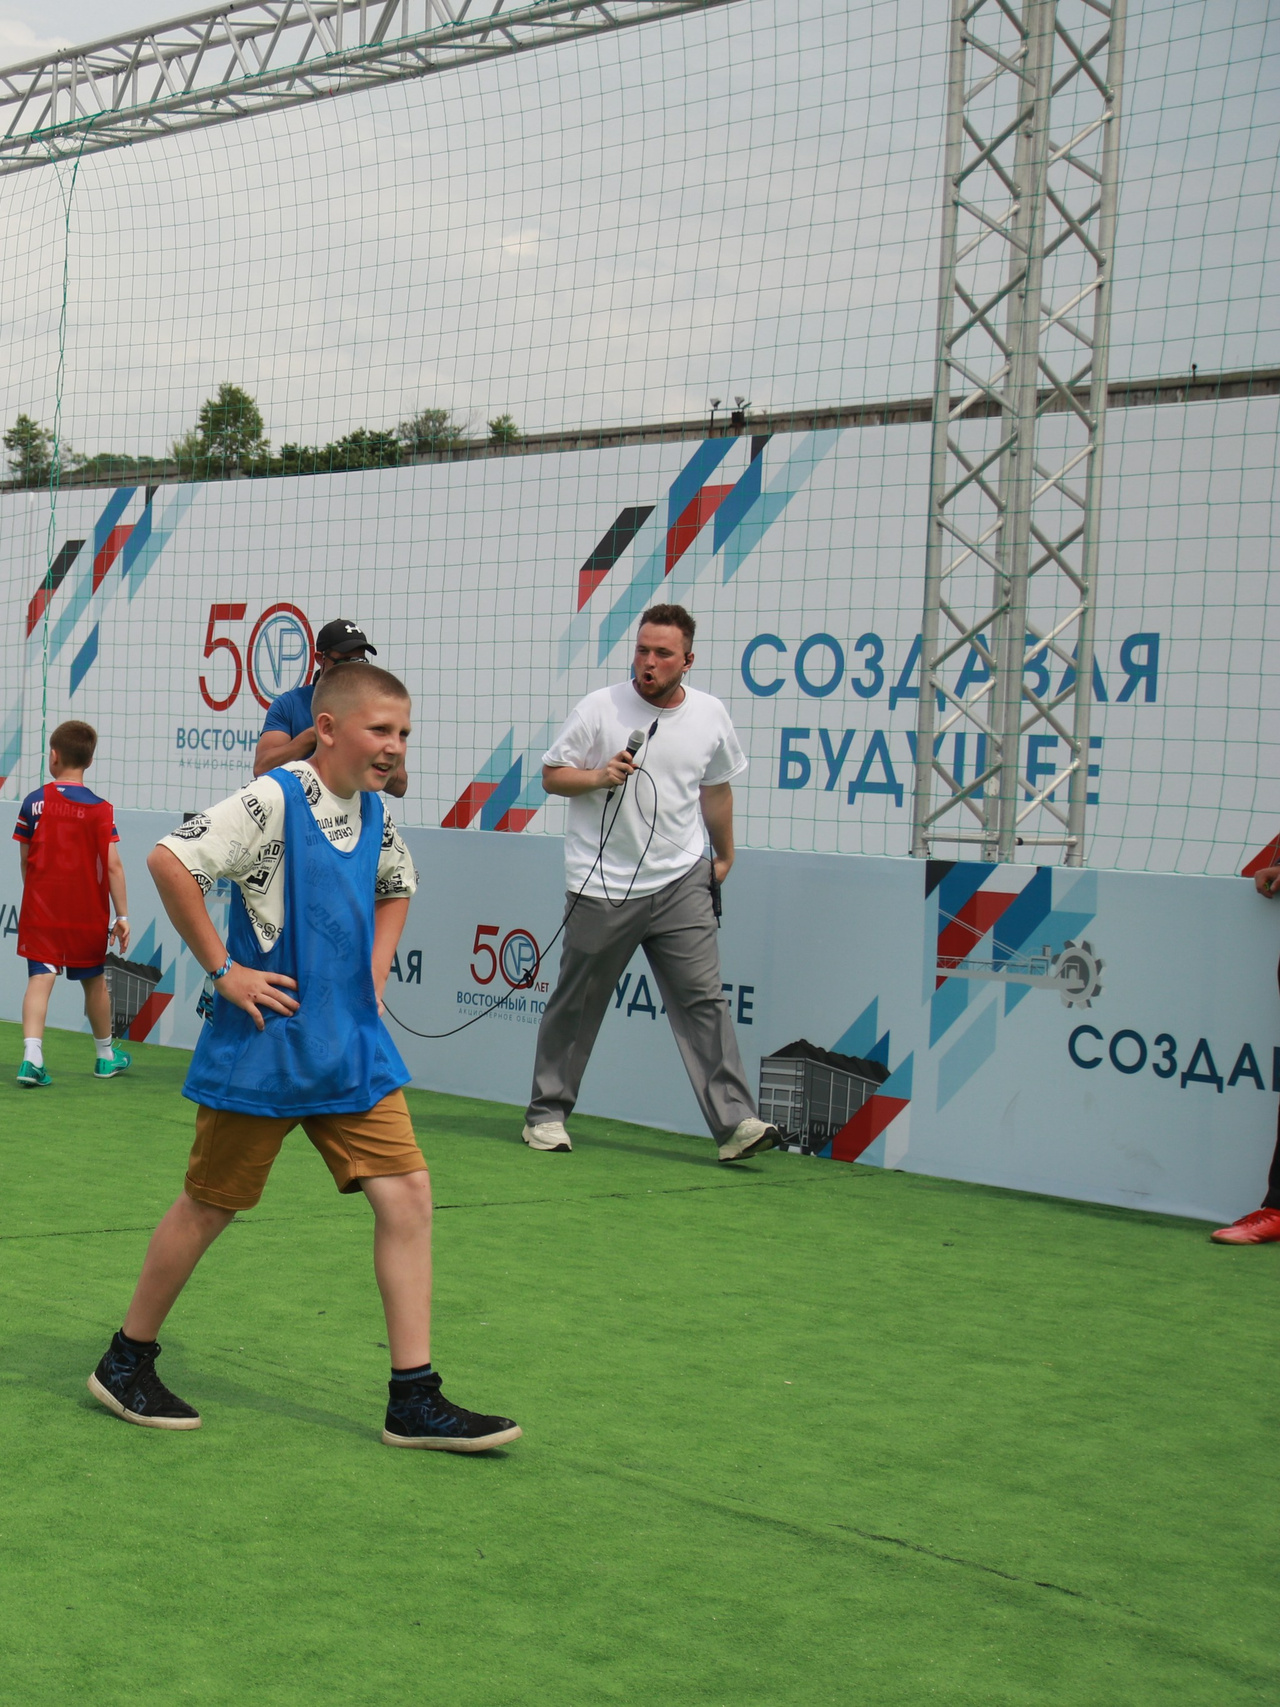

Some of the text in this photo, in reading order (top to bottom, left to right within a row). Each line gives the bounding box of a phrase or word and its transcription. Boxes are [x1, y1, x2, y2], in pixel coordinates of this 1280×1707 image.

[199, 603, 315, 711] 50
[176, 728, 260, 752] ВОСТОЧН
[179, 758, 252, 771] АКЦИОНЕРН
[469, 924, 549, 993] 50 ЛЕТ
[456, 990, 547, 1015] ВОСТОЧНЫЙ ПО
[1068, 1024, 1280, 1094] СОЗДА
